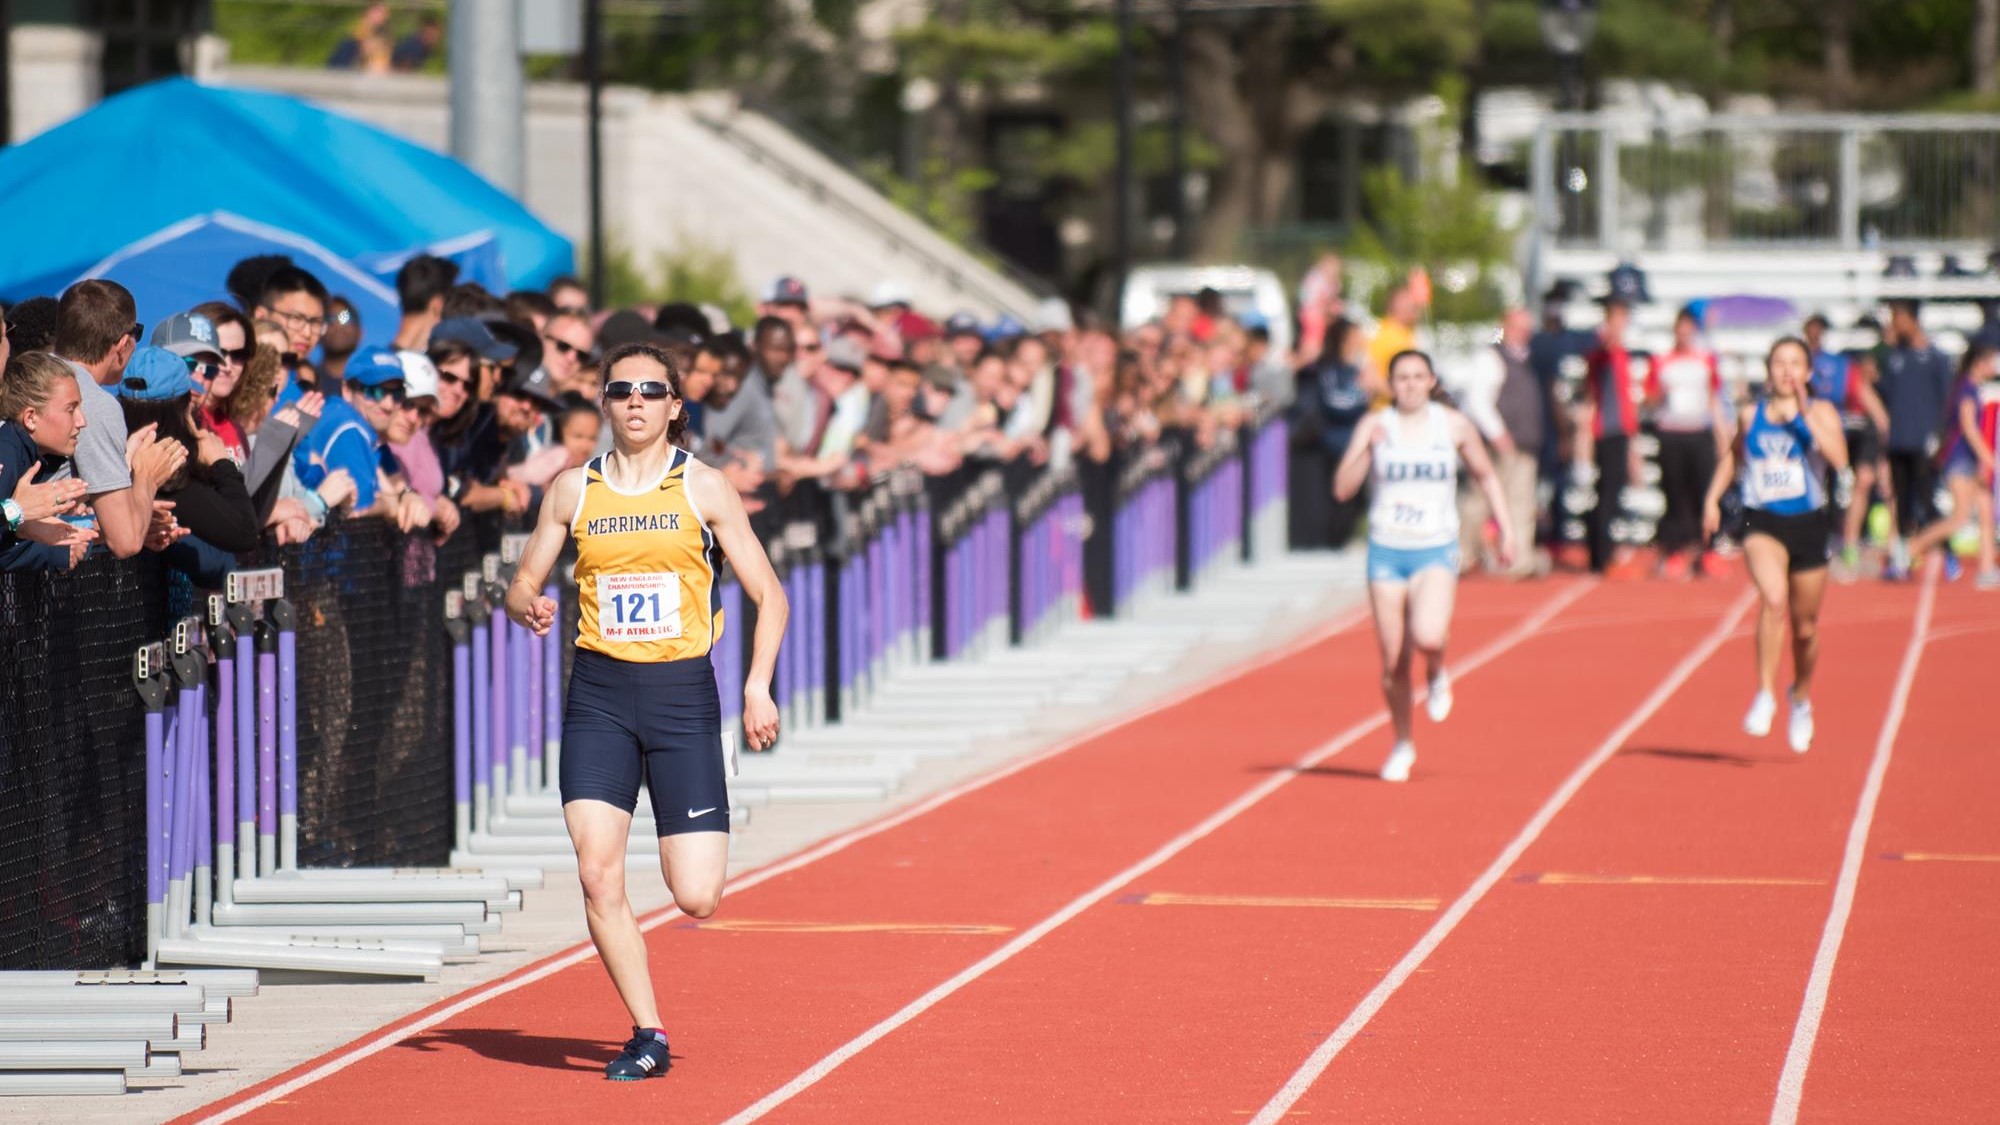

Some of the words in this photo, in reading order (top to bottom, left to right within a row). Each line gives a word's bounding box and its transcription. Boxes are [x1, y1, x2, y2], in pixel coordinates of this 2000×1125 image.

[1386, 461, 1447, 481] URI
[588, 514, 679, 535] MERRIMACK
[611, 593, 660, 623] 121
[627, 626, 673, 635] ATHLETIC
